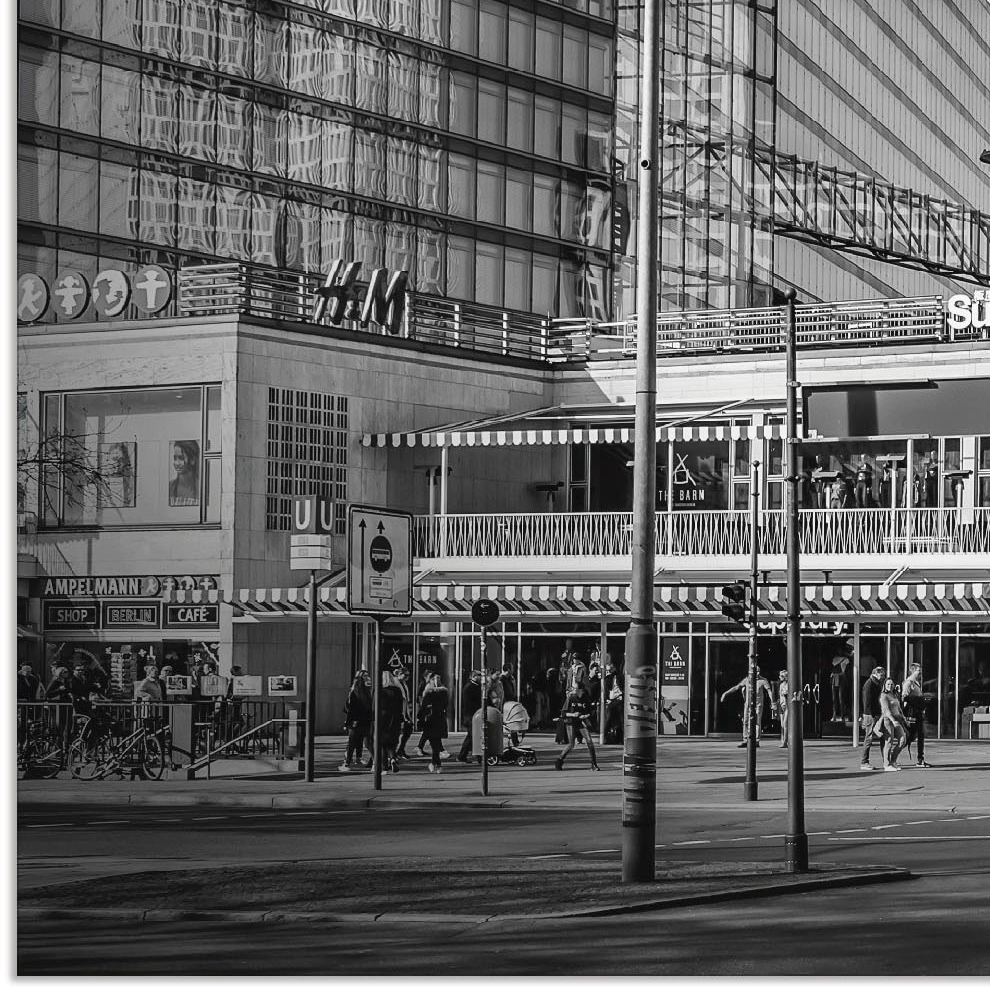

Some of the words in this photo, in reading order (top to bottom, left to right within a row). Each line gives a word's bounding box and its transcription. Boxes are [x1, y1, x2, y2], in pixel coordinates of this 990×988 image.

[680, 489, 705, 501] BARN
[295, 499, 311, 530] U
[320, 500, 333, 531] U
[45, 577, 140, 596] AMPELMANN
[57, 609, 88, 622] SHOP
[111, 609, 152, 622] BERLIN
[177, 605, 208, 622] CAFÉ
